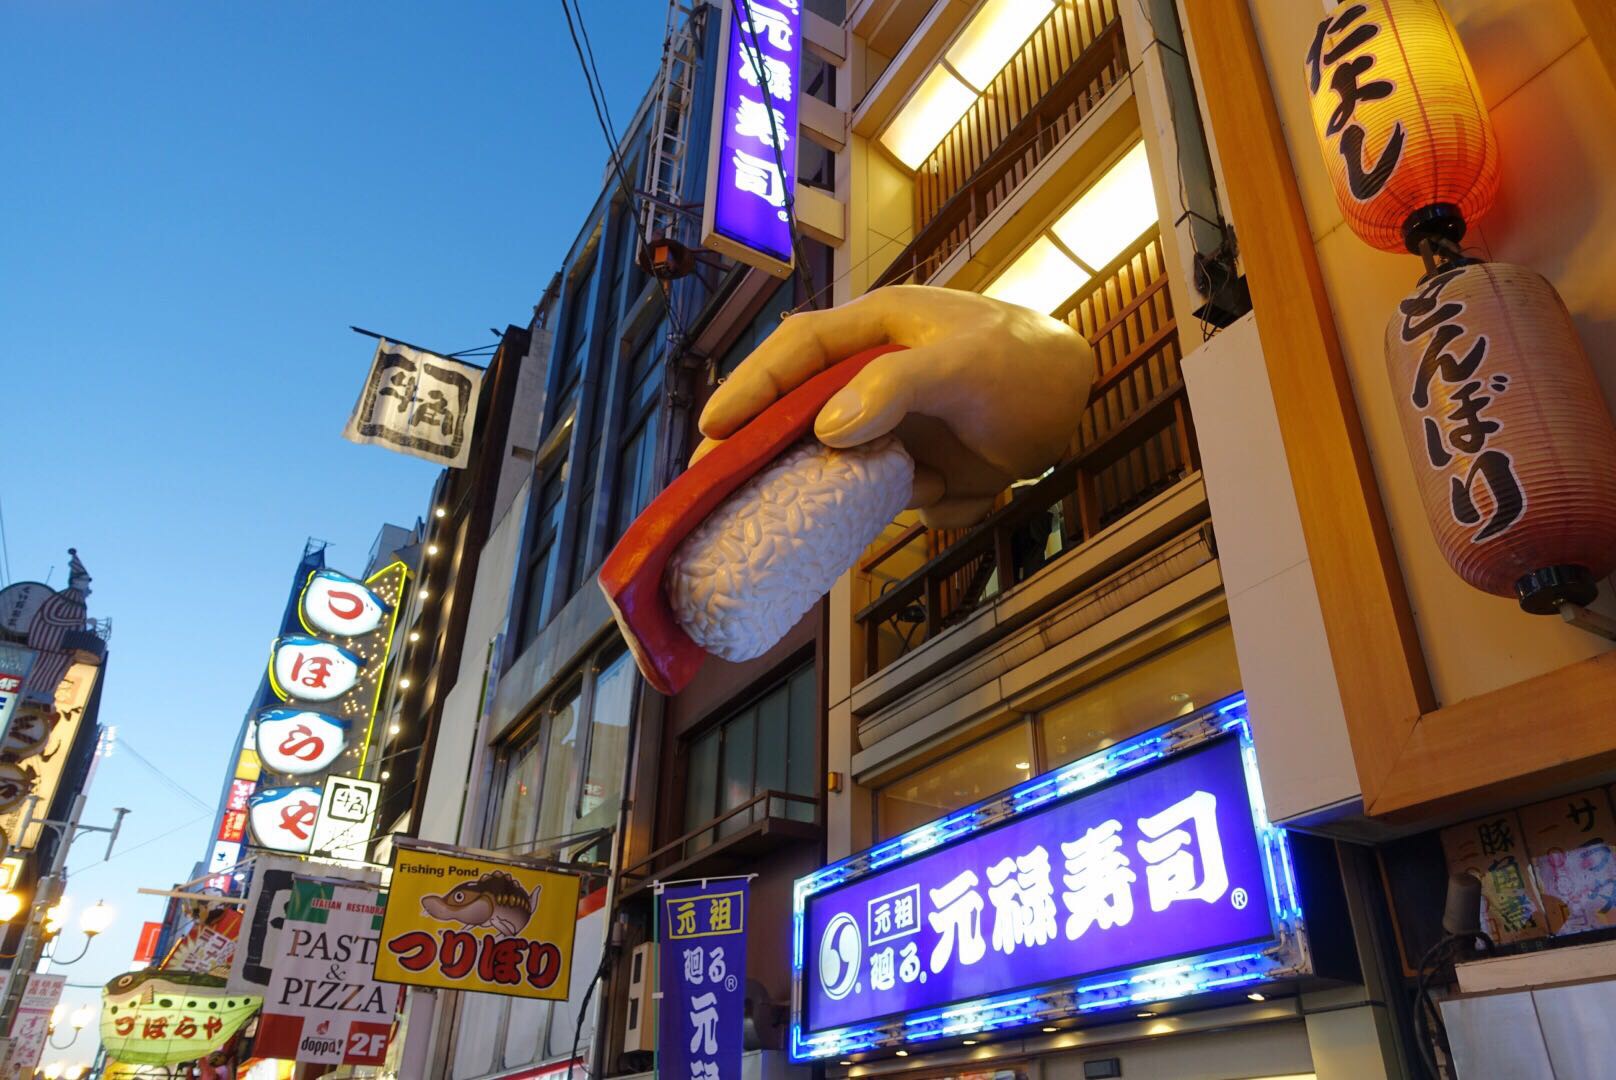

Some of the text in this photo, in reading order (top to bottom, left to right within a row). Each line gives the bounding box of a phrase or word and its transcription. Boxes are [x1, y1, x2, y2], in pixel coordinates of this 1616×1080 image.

[399, 863, 479, 878] Fishing Pond
[312, 898, 342, 911] ITALIAN
[677, 897, 731, 935] 元祖
[874, 895, 914, 936] 元祖
[286, 928, 379, 965] PAST
[388, 930, 561, 989] つりぼり
[326, 963, 346, 981] &
[278, 976, 388, 1014] PIZZA
[348, 1033, 387, 1057] 2F
